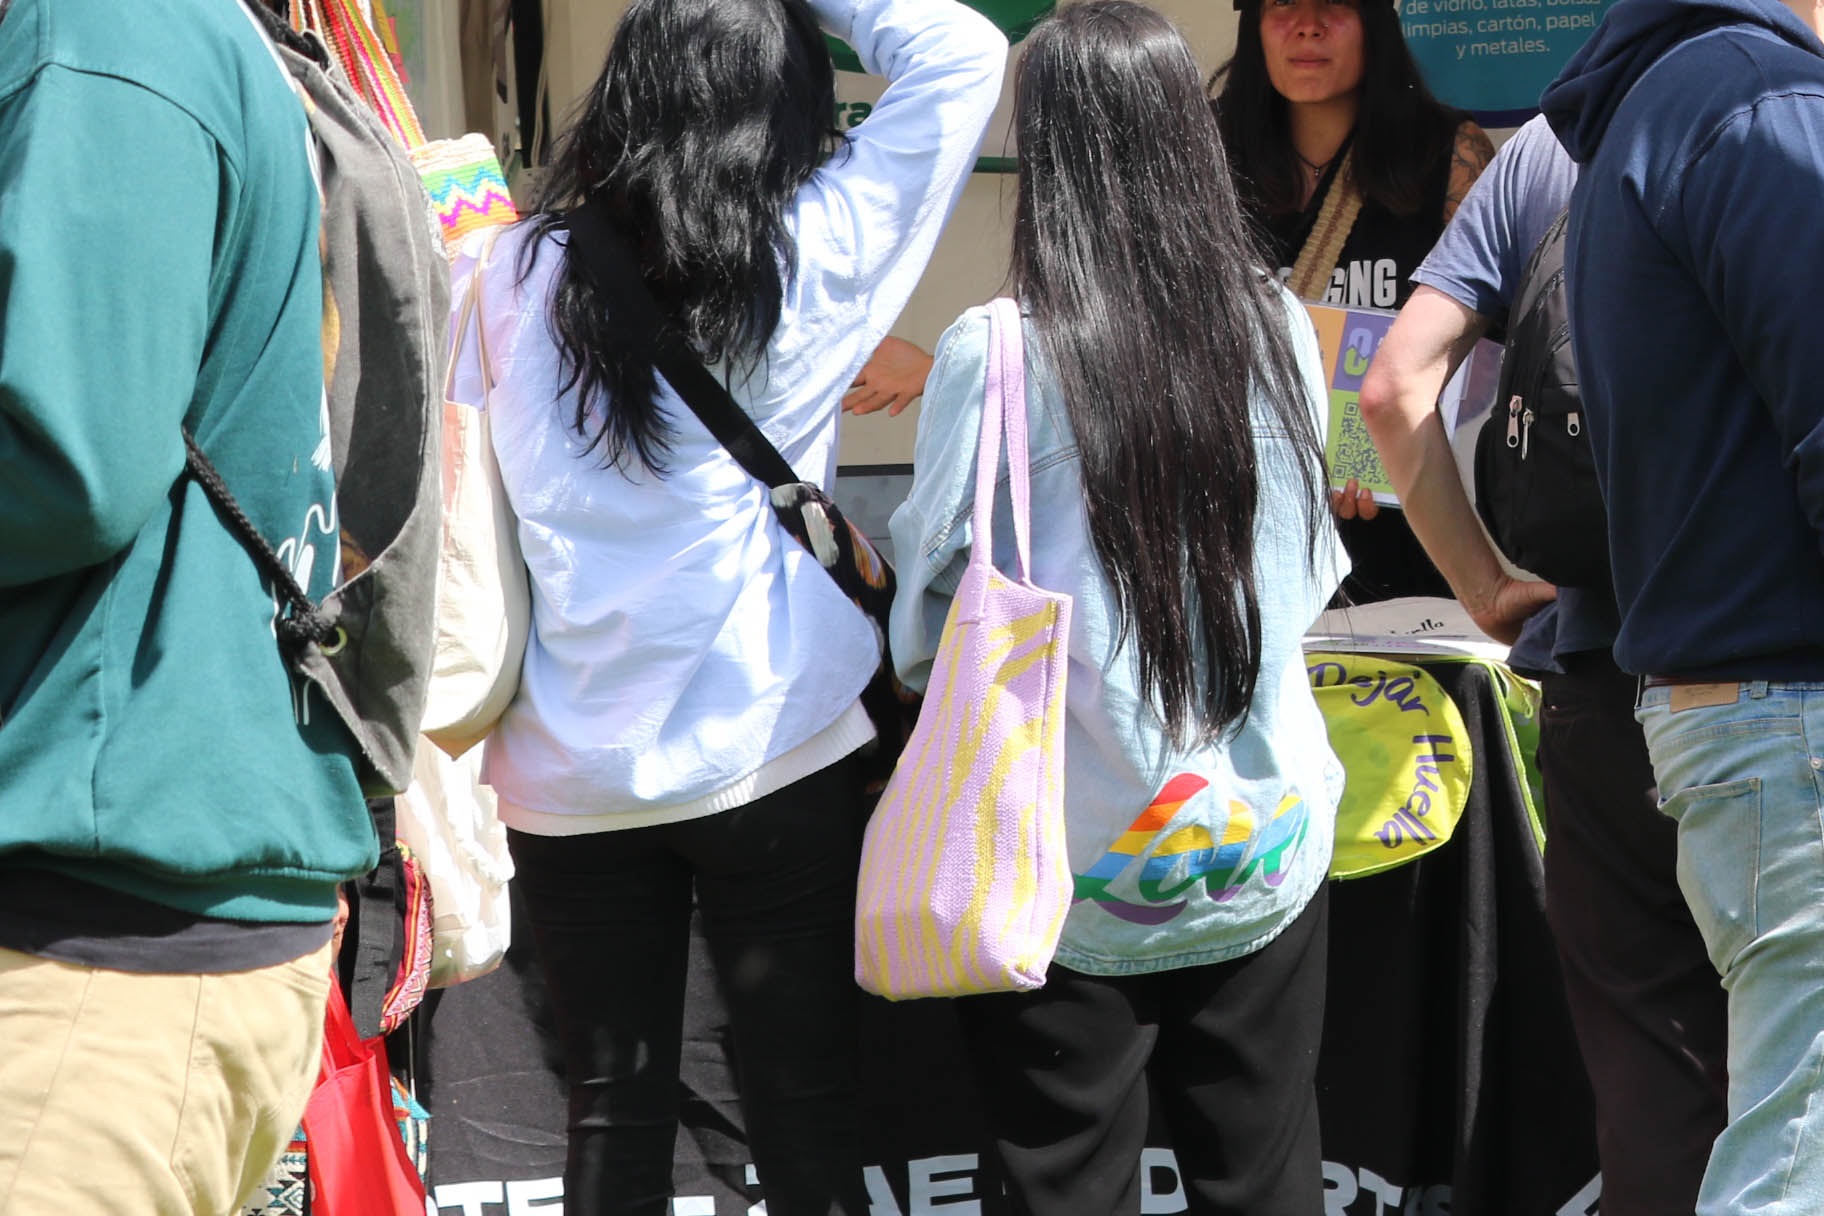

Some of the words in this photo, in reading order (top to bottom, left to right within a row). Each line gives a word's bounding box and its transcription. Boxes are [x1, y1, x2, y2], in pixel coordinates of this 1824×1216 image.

[1403, 19, 1473, 40] limpias,
[1477, 15, 1542, 35] cartón,
[1547, 11, 1596, 33] papel
[1456, 44, 1466, 60] y
[1471, 38, 1551, 56] metales.
[1307, 662, 1430, 717] Dejar
[1374, 734, 1455, 849] Huella
